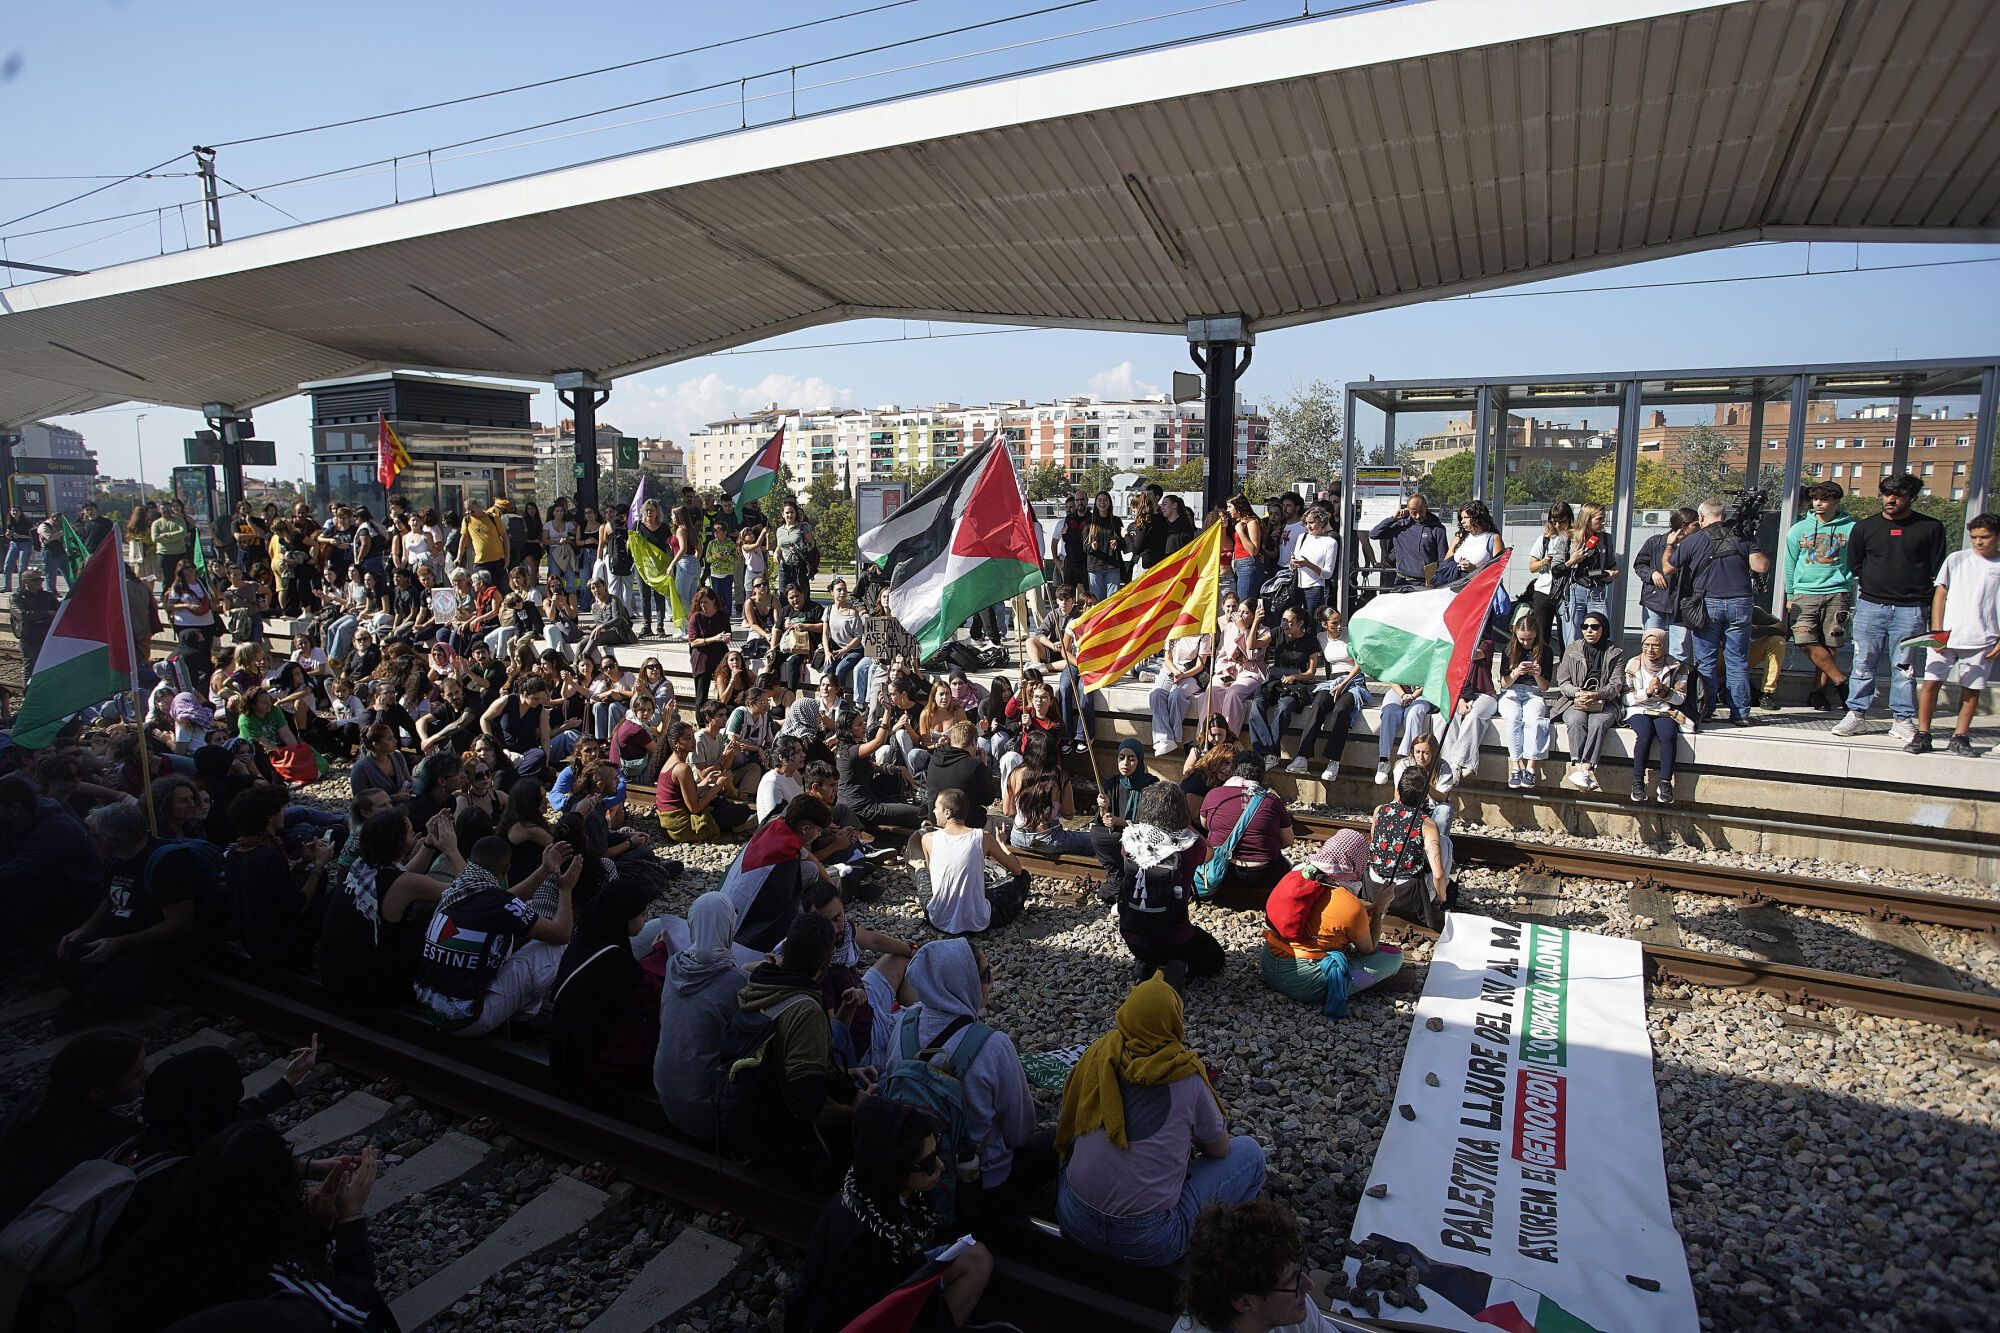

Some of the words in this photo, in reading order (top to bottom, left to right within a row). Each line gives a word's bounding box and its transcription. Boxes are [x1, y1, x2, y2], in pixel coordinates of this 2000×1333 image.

[47, 462, 74, 471] Girona
[866, 618, 905, 633] NETAN
[1486, 957, 1519, 980] AL
[1479, 977, 1516, 1010] RIU
[1473, 1012, 1512, 1046] DEL
[1460, 1042, 1508, 1131] LLIURE
[1521, 1071, 1558, 1167] GENOCIDI
[1520, 1166, 1557, 1186] EL
[1440, 1137, 1501, 1257] PALESTINA
[1518, 1187, 1559, 1264] ATUREM
